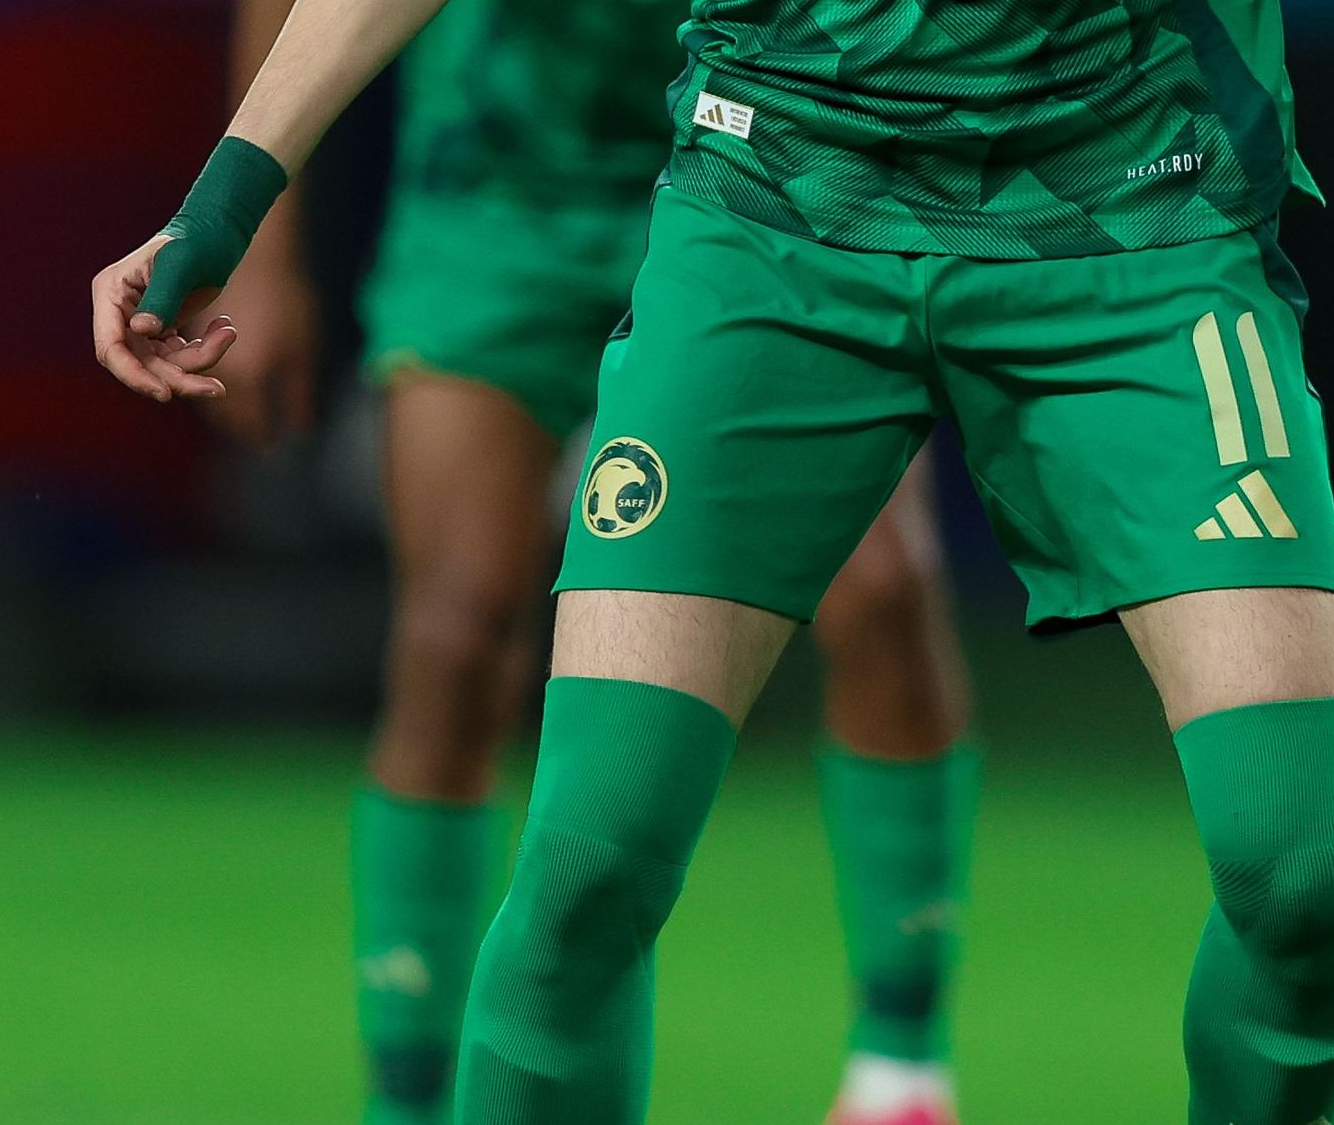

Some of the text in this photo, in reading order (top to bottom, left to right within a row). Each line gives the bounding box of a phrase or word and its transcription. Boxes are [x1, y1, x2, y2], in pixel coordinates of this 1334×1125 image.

[1127, 153, 1203, 180] HEAT.RDY
[1192, 310, 1291, 466] 11
[617, 498, 646, 508] SAFF
